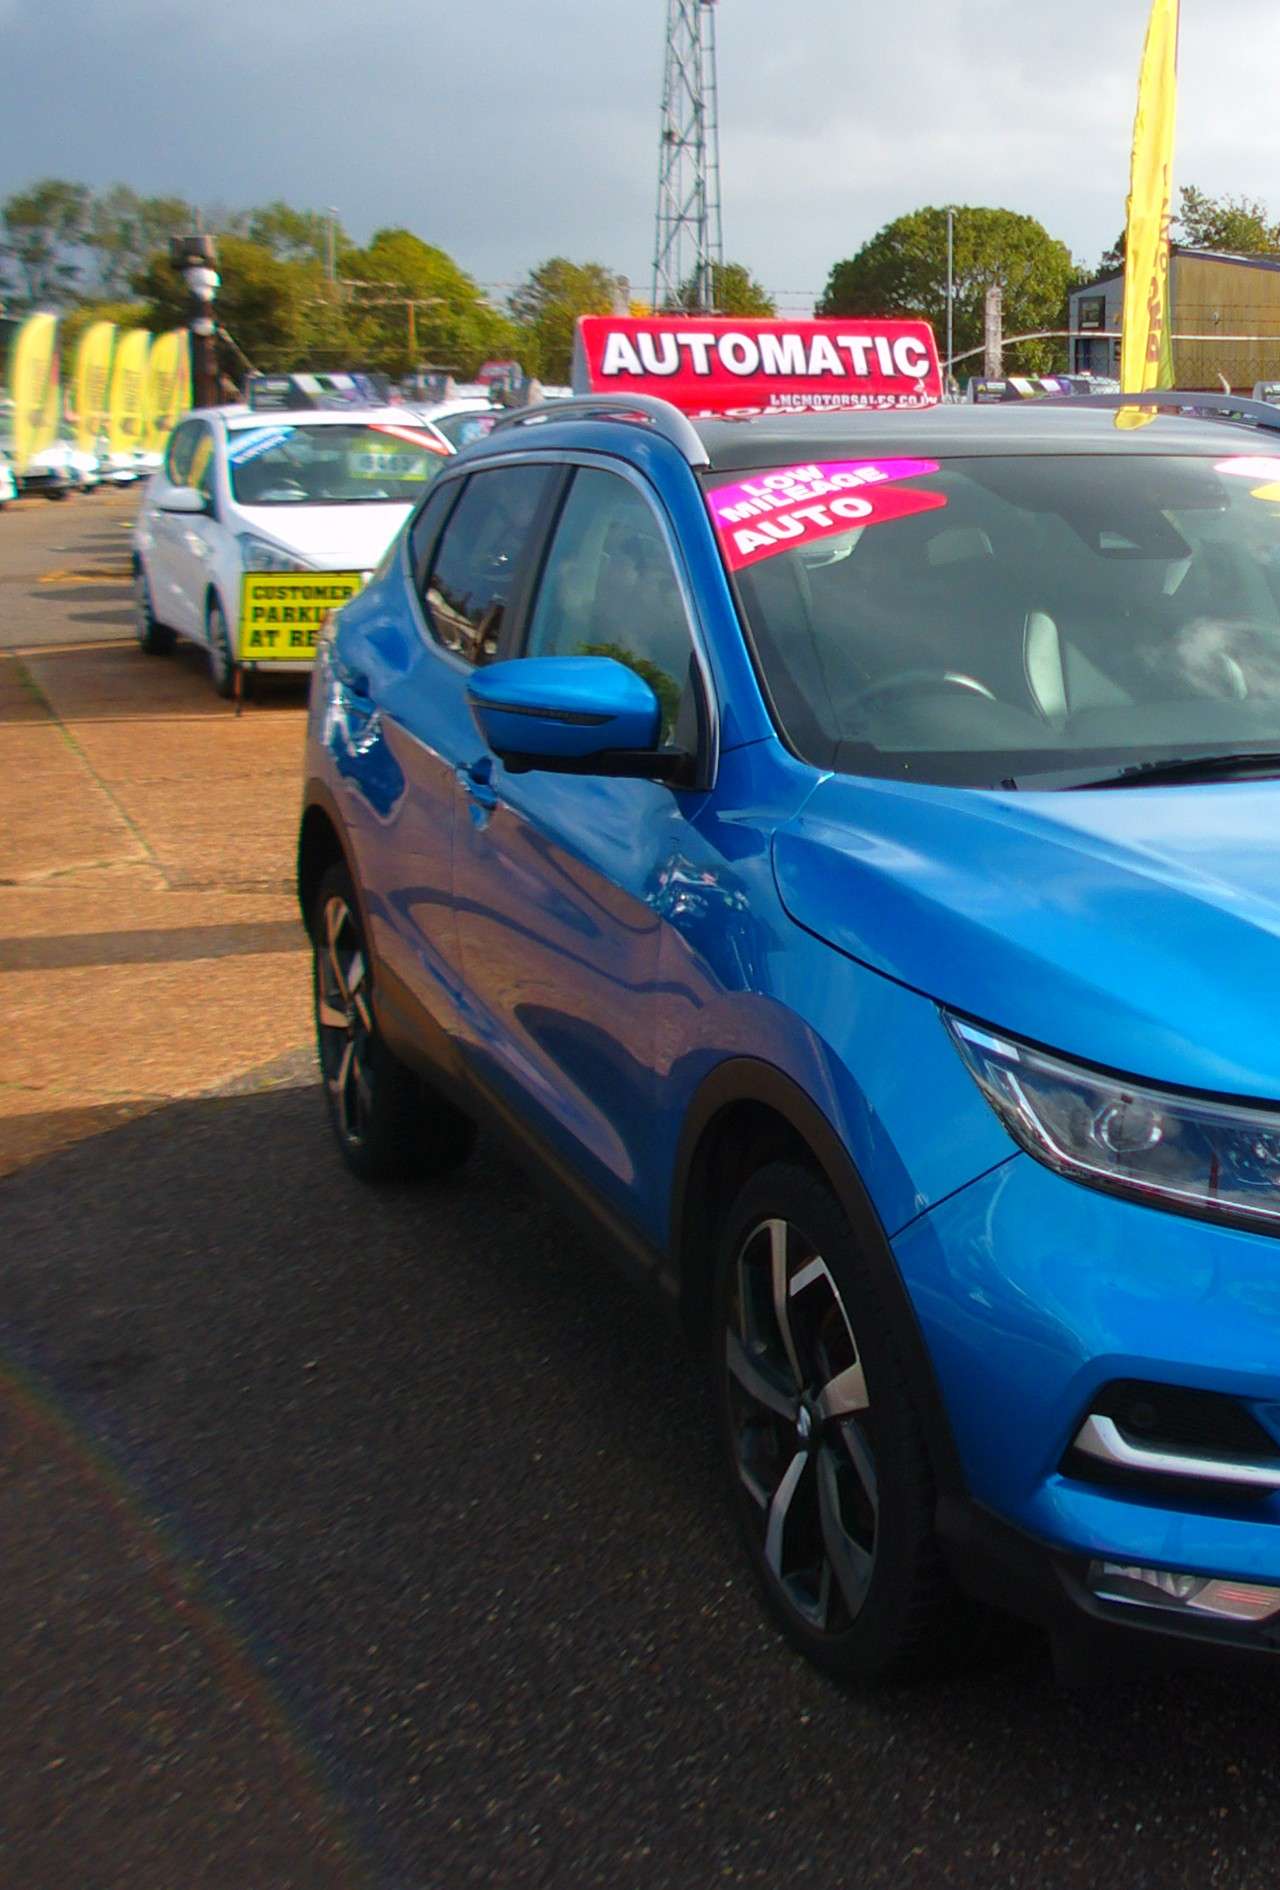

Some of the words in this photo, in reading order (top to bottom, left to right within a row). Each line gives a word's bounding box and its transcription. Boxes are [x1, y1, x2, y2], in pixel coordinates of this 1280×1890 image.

[602, 332, 931, 378] AUTOMATIC
[718, 467, 889, 522] MILEAGE
[740, 464, 825, 497] LOW
[733, 498, 873, 555] AUTO
[252, 585, 353, 600] CUSTOMER
[252, 606, 322, 623] PARKI
[249, 629, 279, 647] AT
[288, 629, 317, 647] RE
